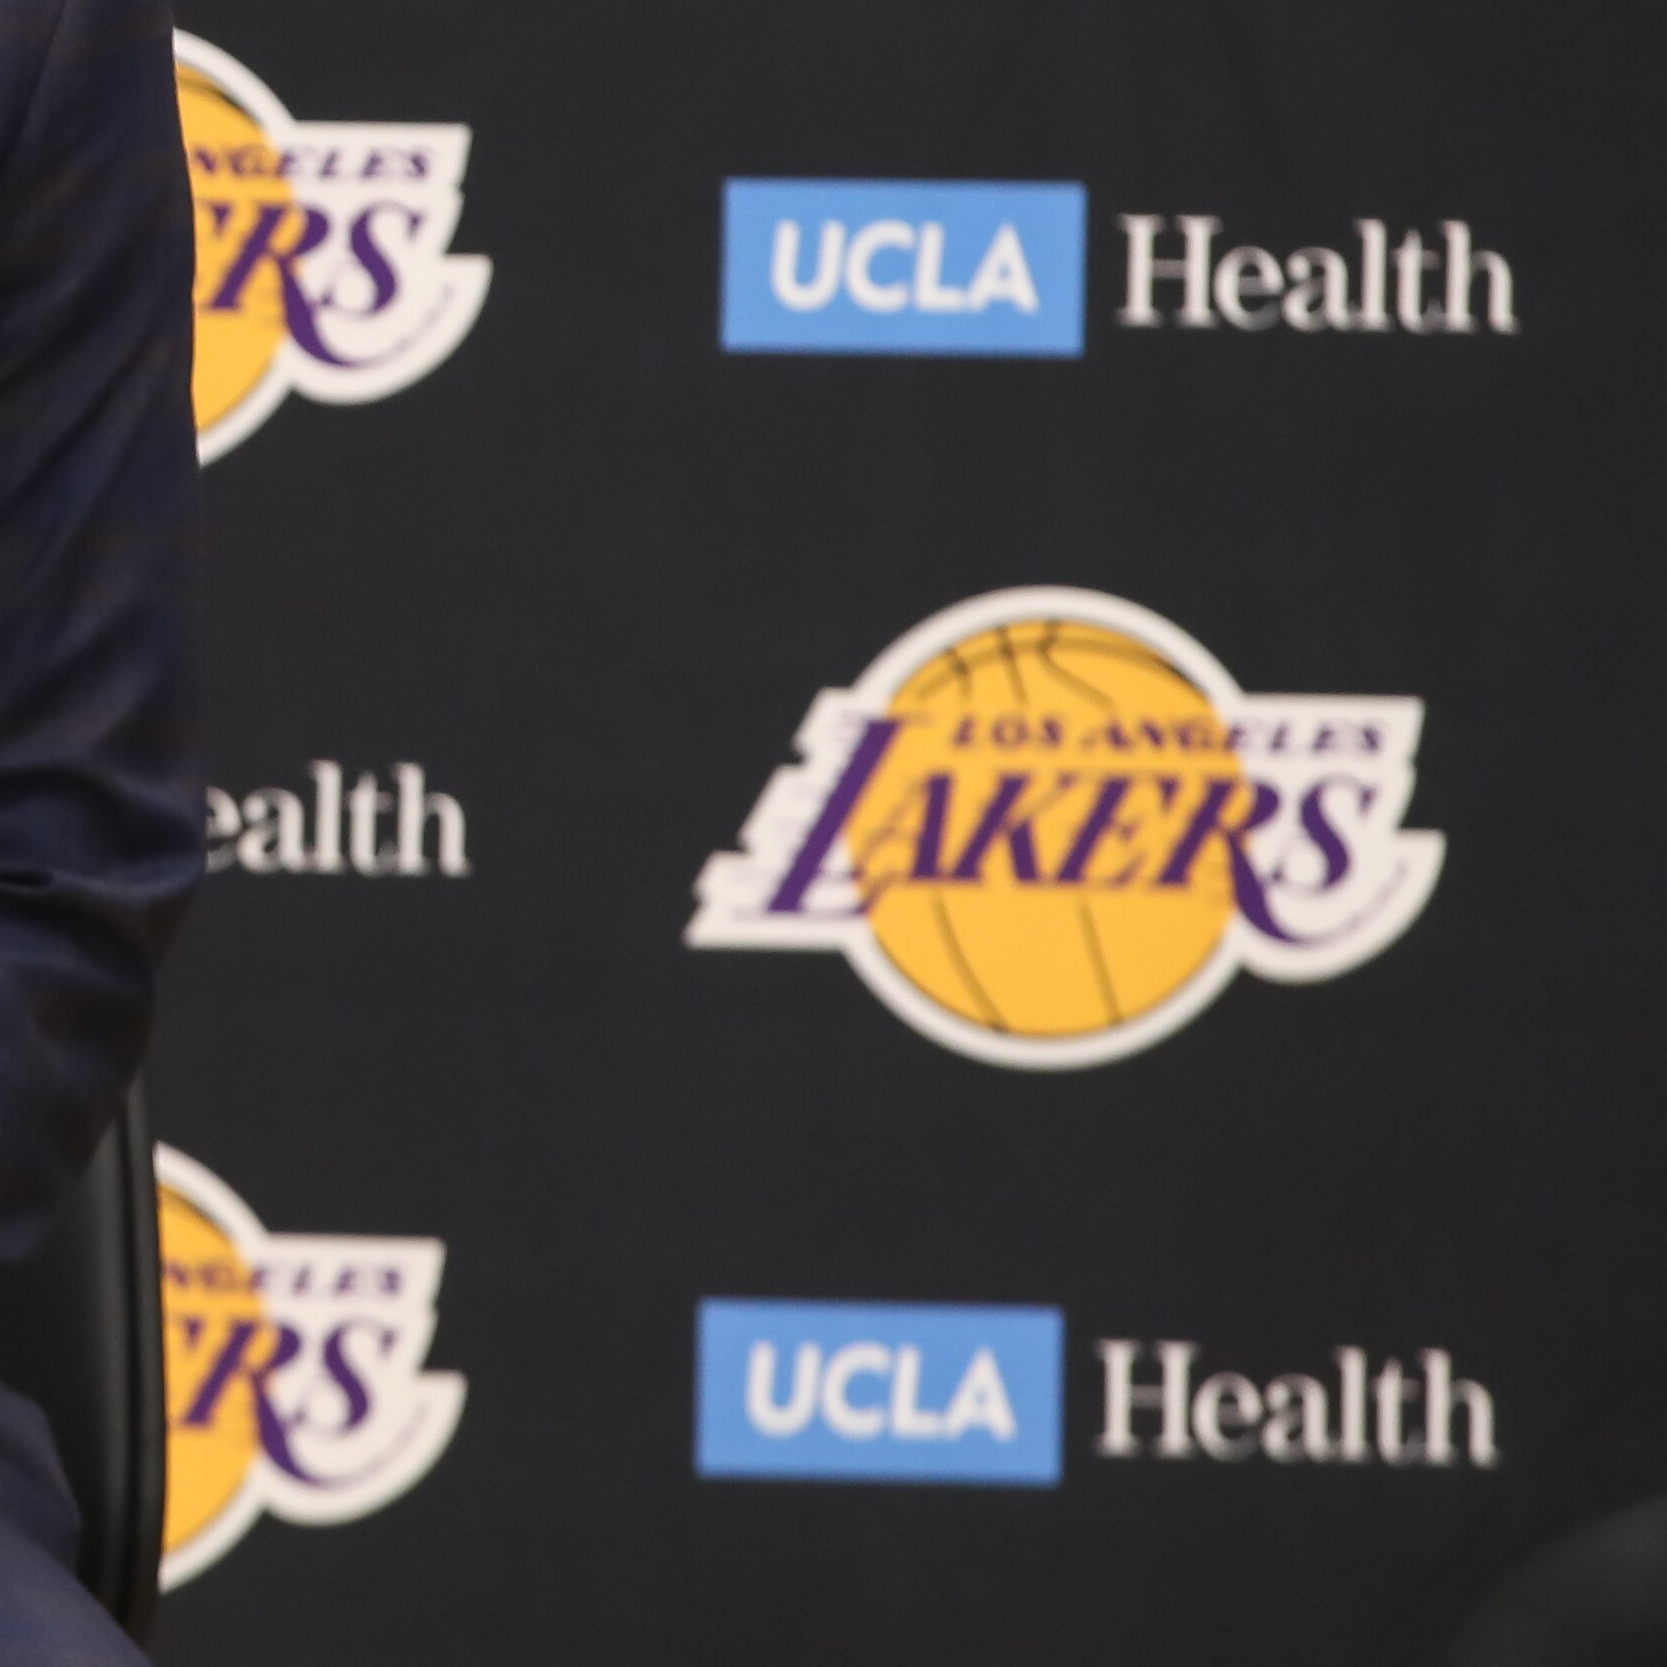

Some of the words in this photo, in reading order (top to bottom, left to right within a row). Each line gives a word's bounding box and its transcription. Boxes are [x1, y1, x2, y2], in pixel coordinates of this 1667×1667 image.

[190, 146, 432, 180] NGELES
[770, 219, 1039, 313] UCLA
[1121, 214, 1515, 333] Health
[949, 713, 1066, 749] LOS
[1079, 715, 1388, 755] ANGELES
[205, 760, 473, 876] ealth
[739, 716, 1407, 943] LAKERS
[163, 1261, 405, 1296] NGELES
[745, 1341, 1016, 1440] UCLA
[1101, 1340, 1495, 1466] Health
